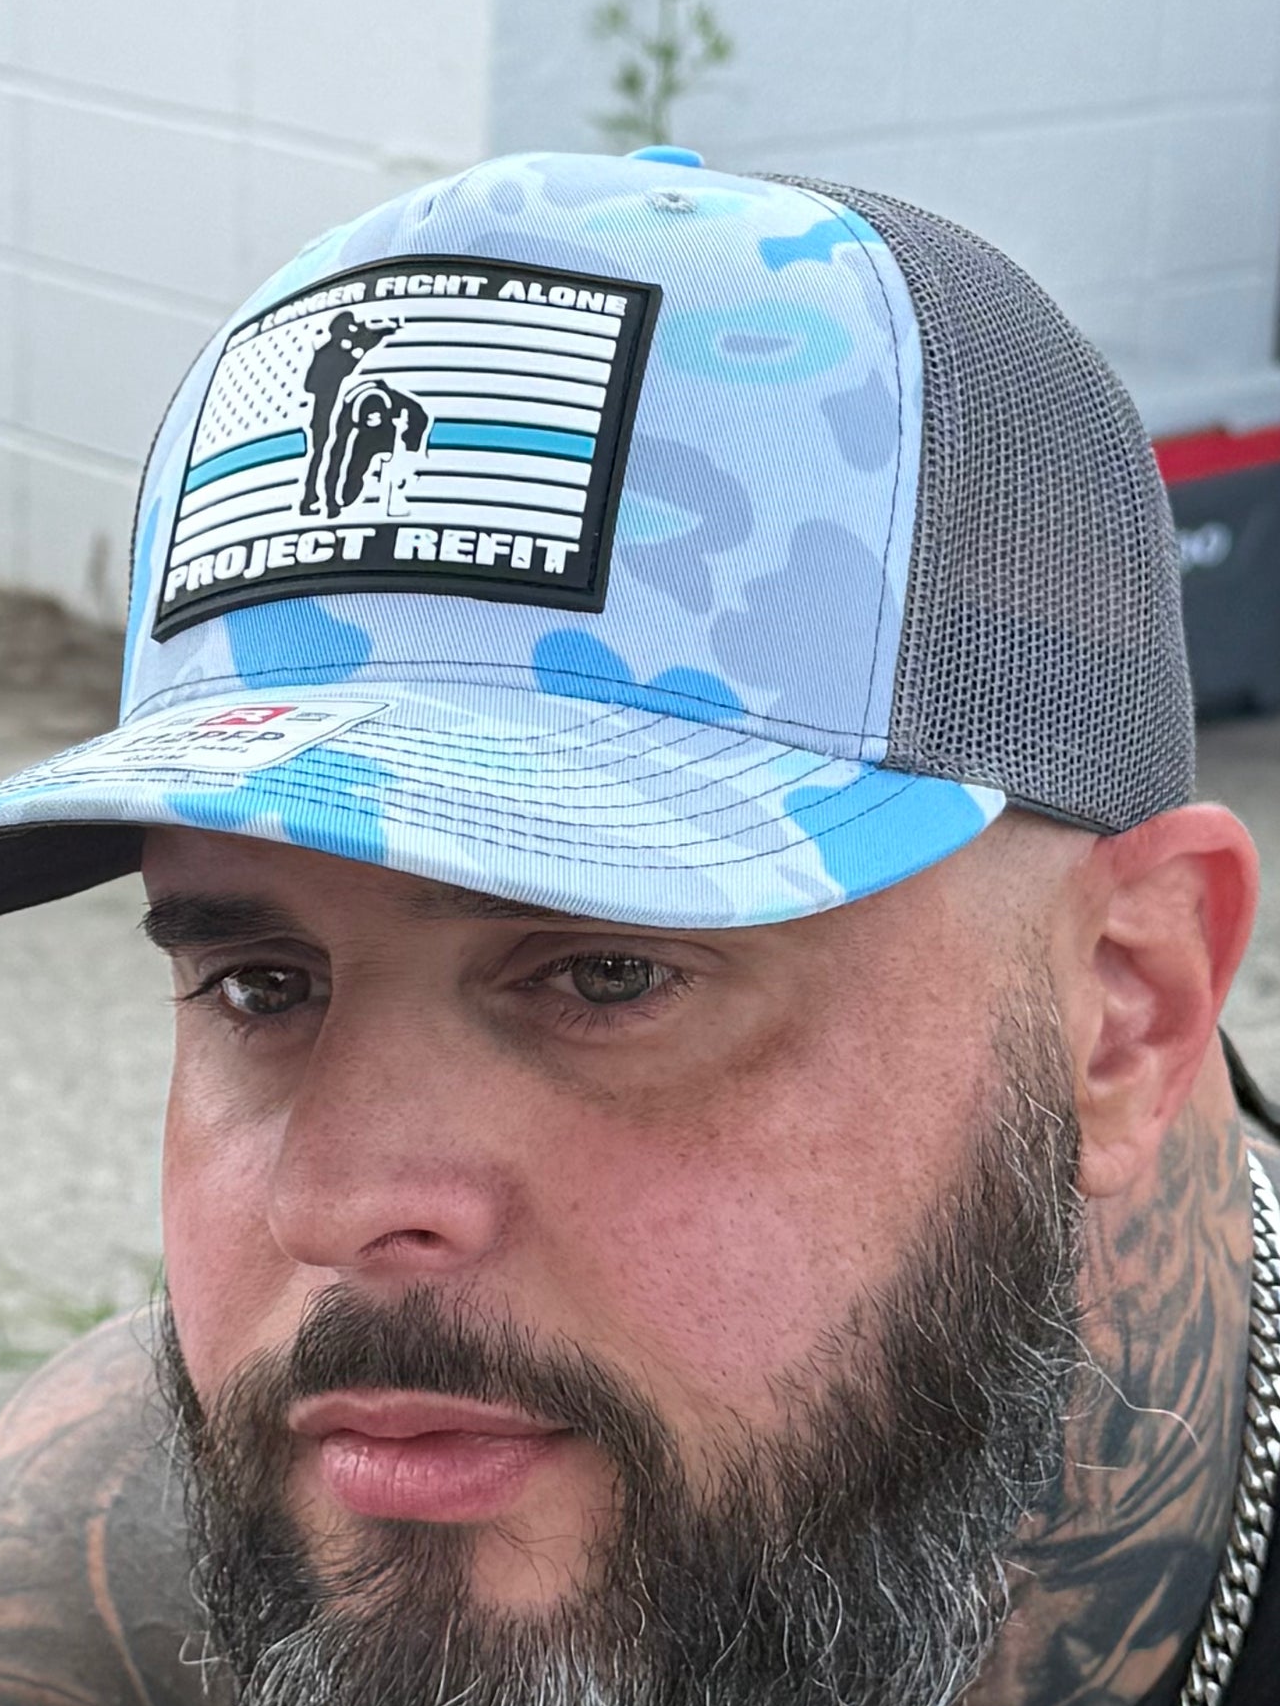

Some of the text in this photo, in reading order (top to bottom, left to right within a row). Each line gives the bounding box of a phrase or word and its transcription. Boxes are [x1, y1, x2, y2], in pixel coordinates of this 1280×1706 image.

[375, 274, 488, 298] FIGHT
[498, 279, 627, 317] ALONE
[164, 527, 580, 602] PROJECT REFIT
